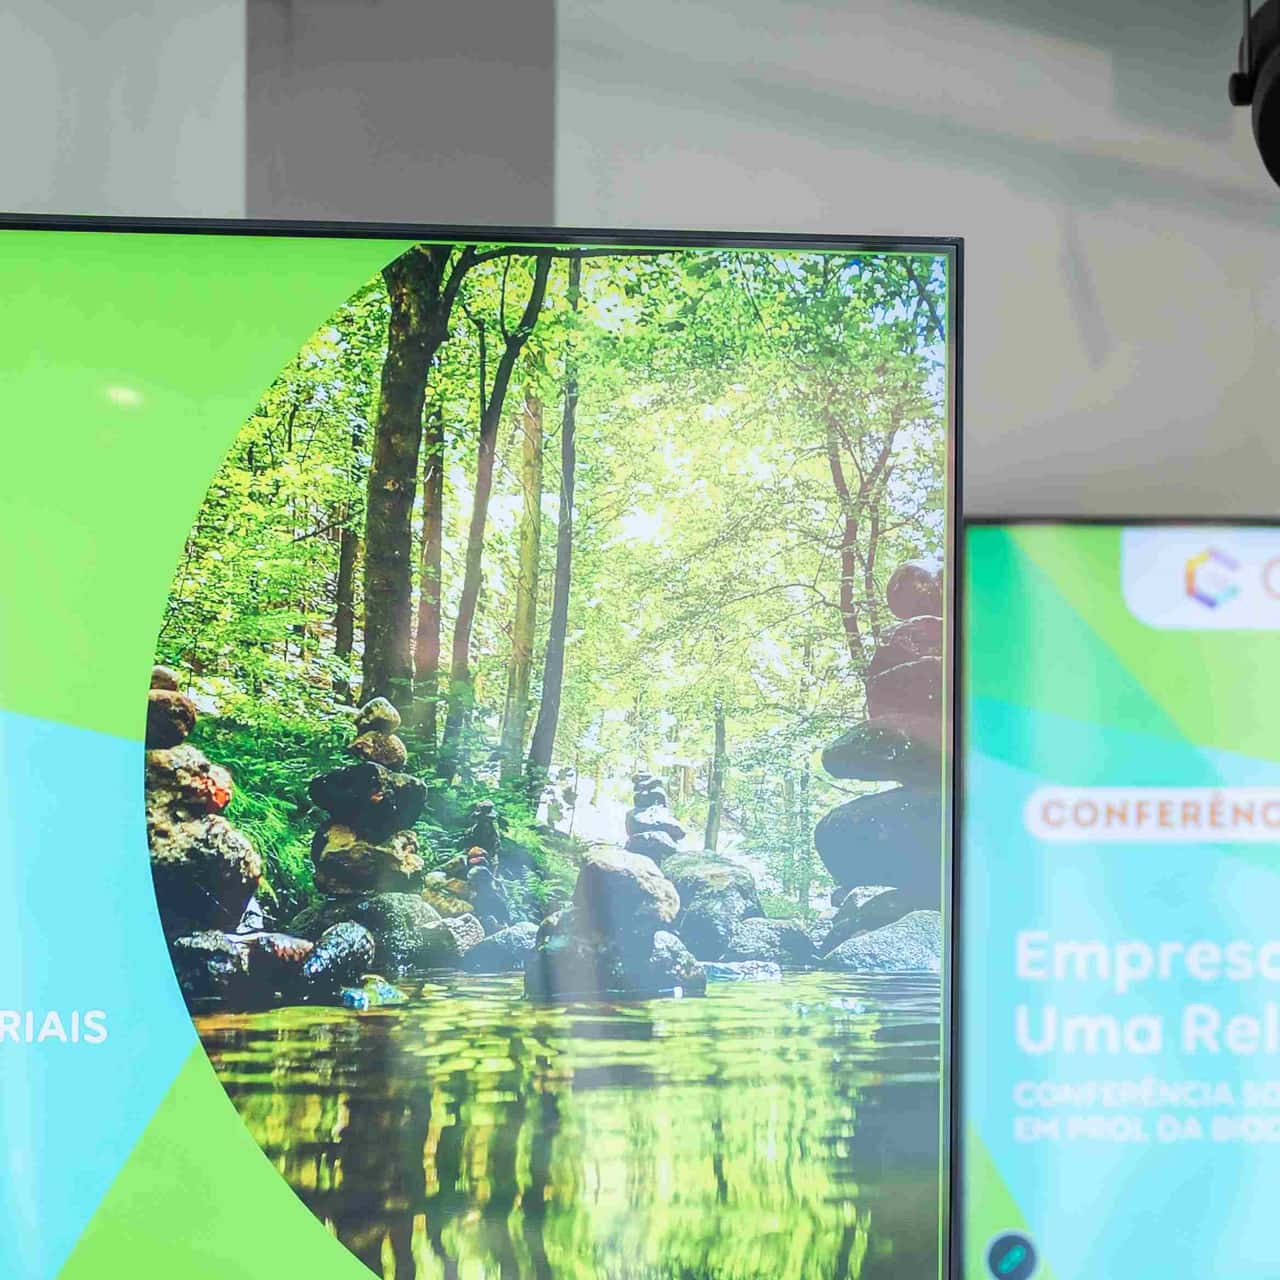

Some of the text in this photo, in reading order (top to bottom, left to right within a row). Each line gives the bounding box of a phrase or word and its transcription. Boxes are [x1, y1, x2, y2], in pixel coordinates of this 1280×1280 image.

[1015, 1004, 1163, 1055] Uma
[1013, 1074, 1234, 1107] CONFERÊNCIA
[1013, 1116, 1060, 1142] EM
[1157, 1116, 1203, 1142] DA
